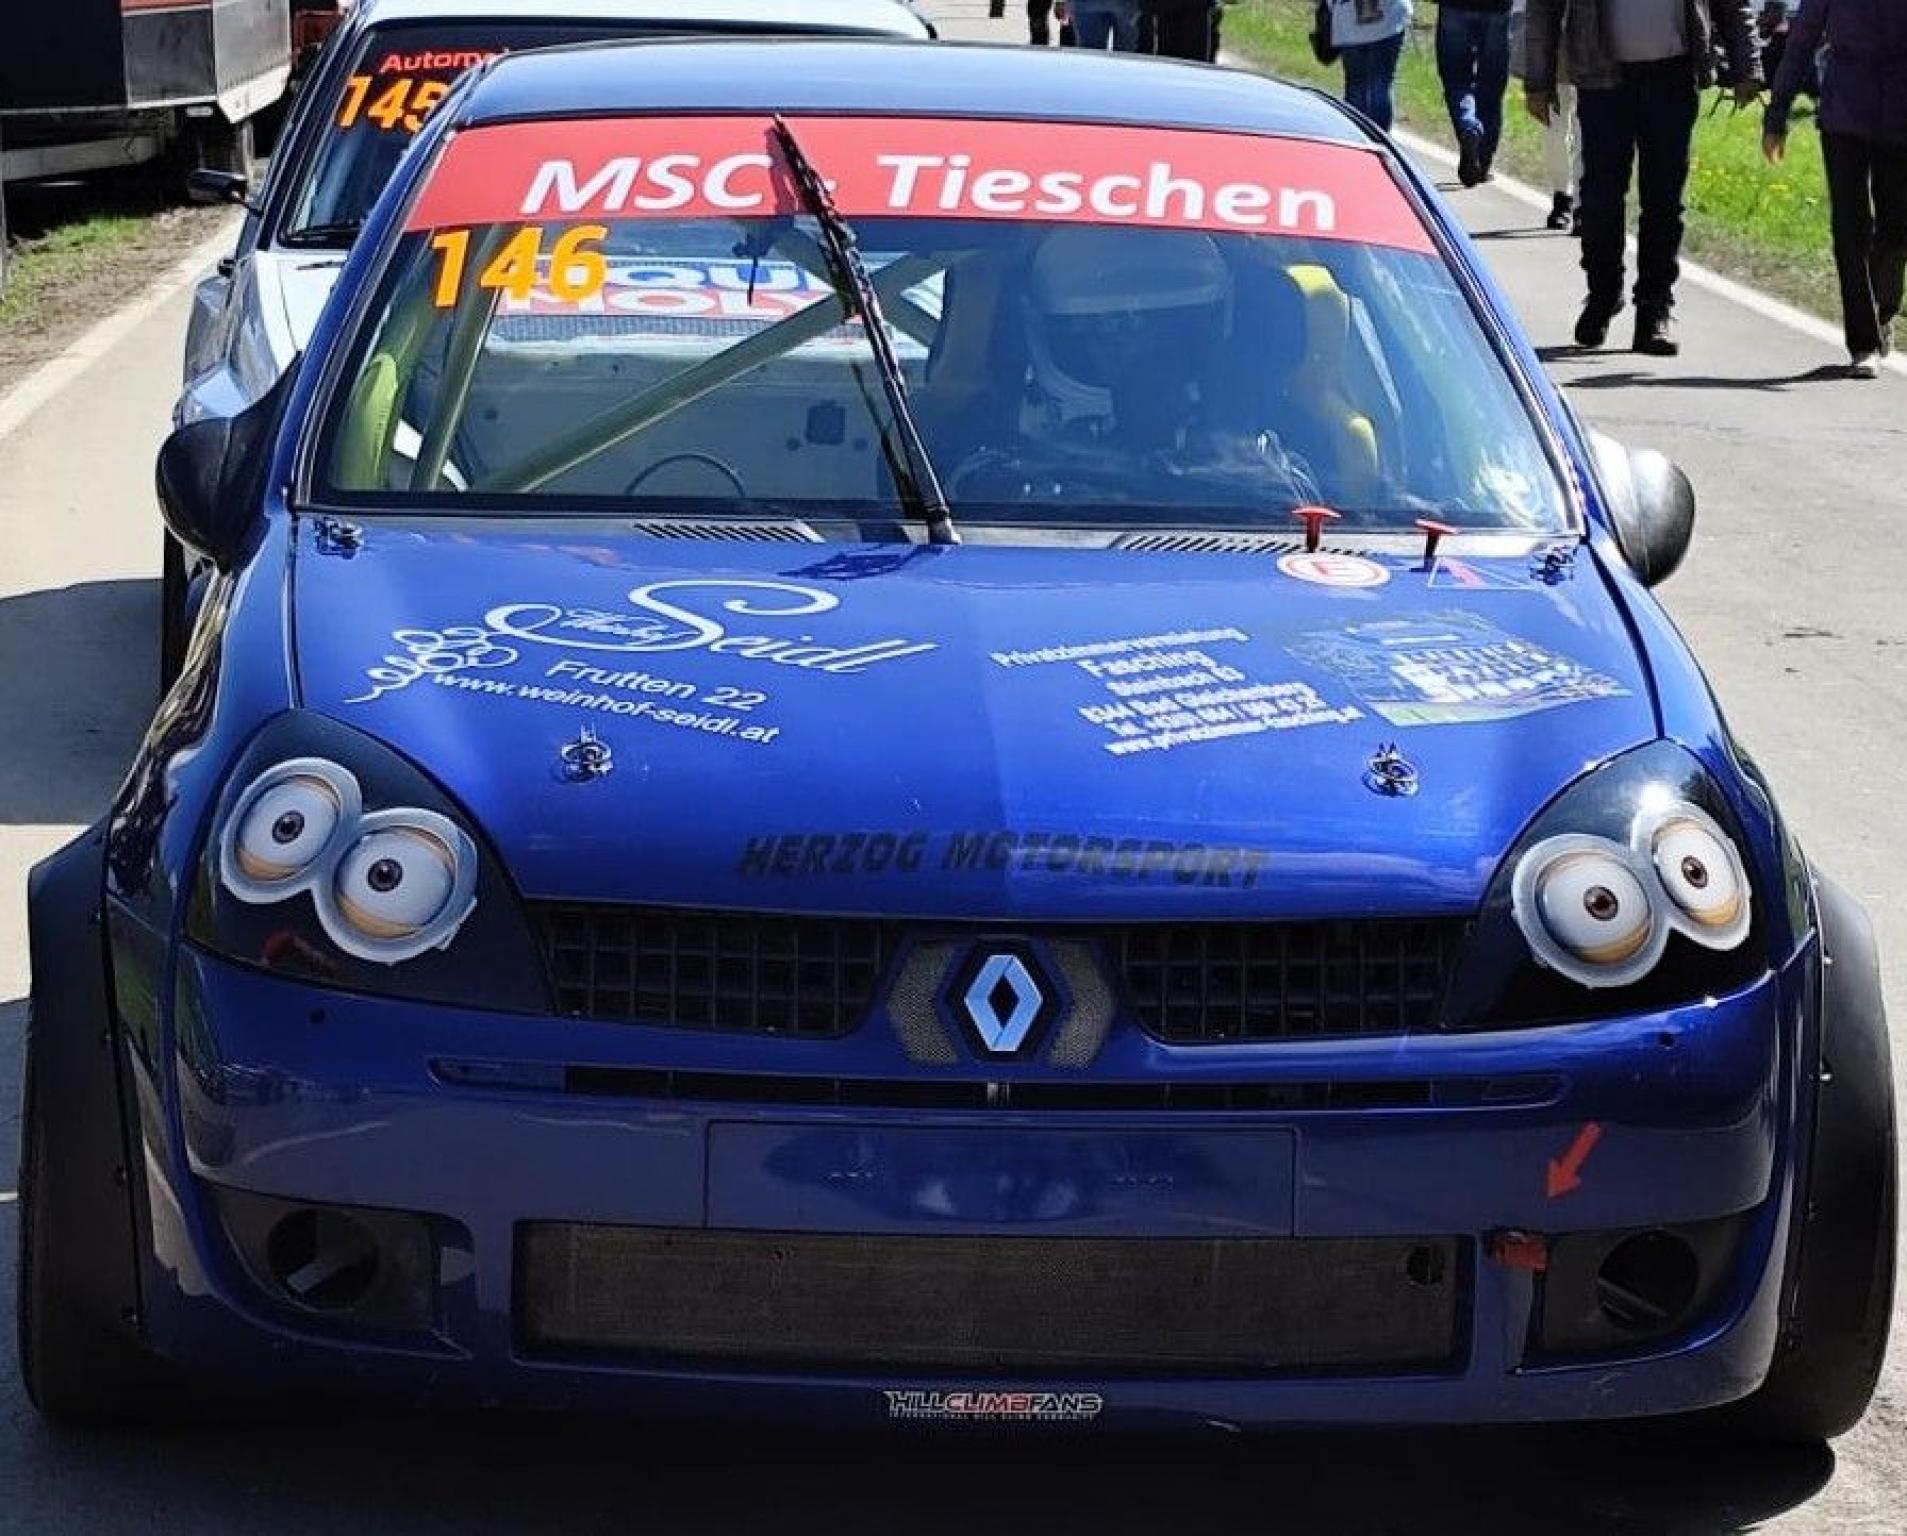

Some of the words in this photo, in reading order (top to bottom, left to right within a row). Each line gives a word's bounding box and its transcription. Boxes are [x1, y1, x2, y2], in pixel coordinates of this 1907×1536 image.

[339, 75, 450, 133] 145
[519, 154, 775, 214] MSC
[876, 154, 1335, 231] Tieschen
[431, 224, 608, 308] 146
[484, 580, 938, 672] Seidl
[544, 660, 697, 698] Frutten
[699, 686, 767, 711] 22
[1076, 650, 1217, 678] Fasching
[433, 672, 780, 744] www.weinhof-seidl.at
[738, 831, 930, 878] HERZOG
[943, 830, 1271, 889] MOTORSPORT
